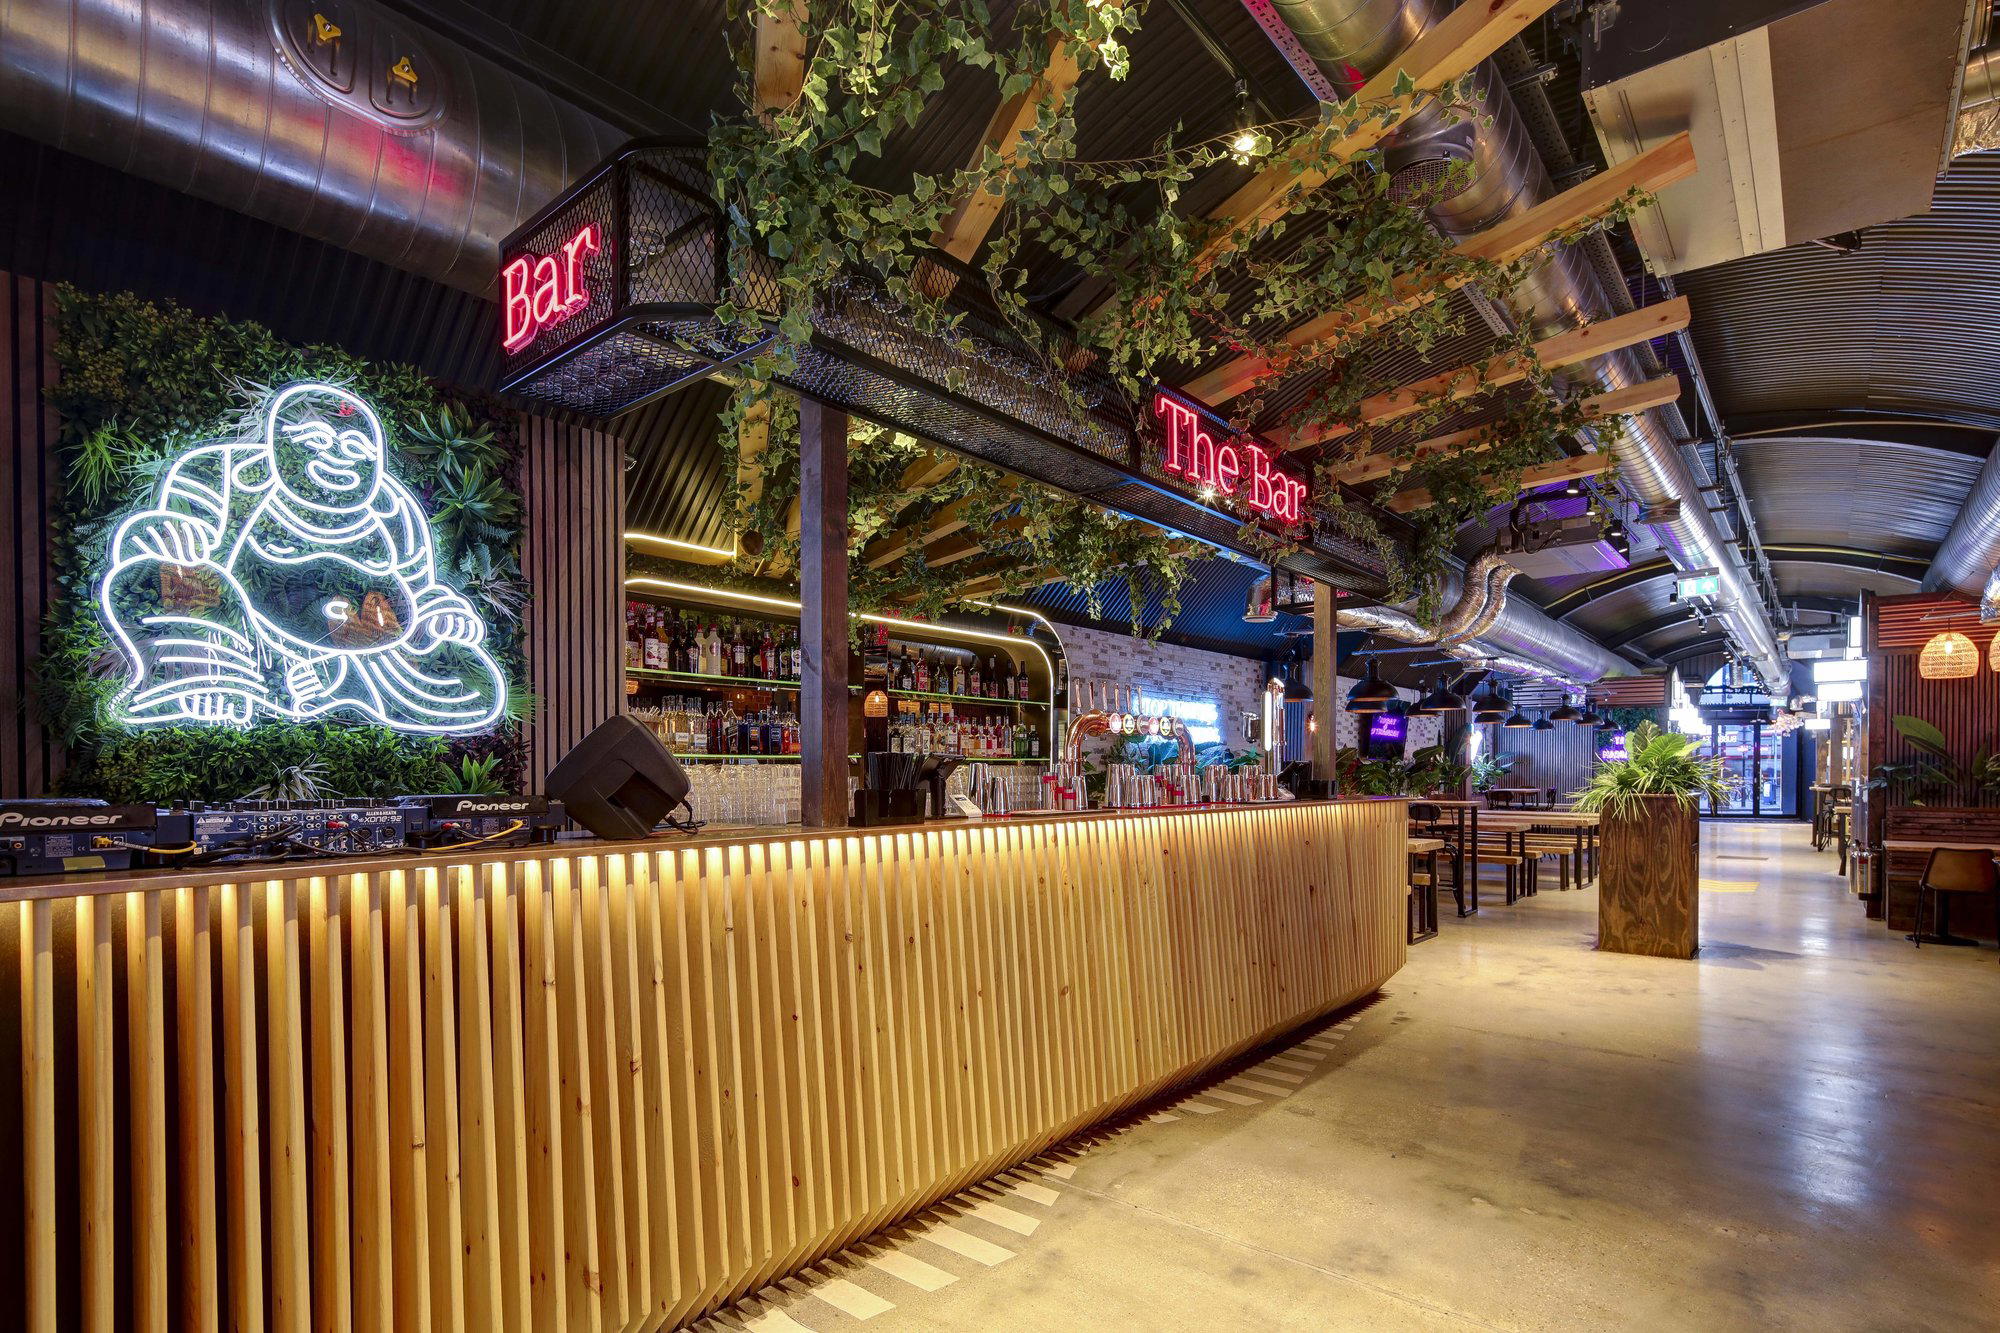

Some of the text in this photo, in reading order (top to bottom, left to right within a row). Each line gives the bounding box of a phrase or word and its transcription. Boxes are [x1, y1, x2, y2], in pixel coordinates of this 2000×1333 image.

[502, 226, 597, 349] Bar
[1158, 396, 1307, 521] The Bar
[0, 812, 123, 828] Pioneer
[456, 800, 530, 812] Pioneer
